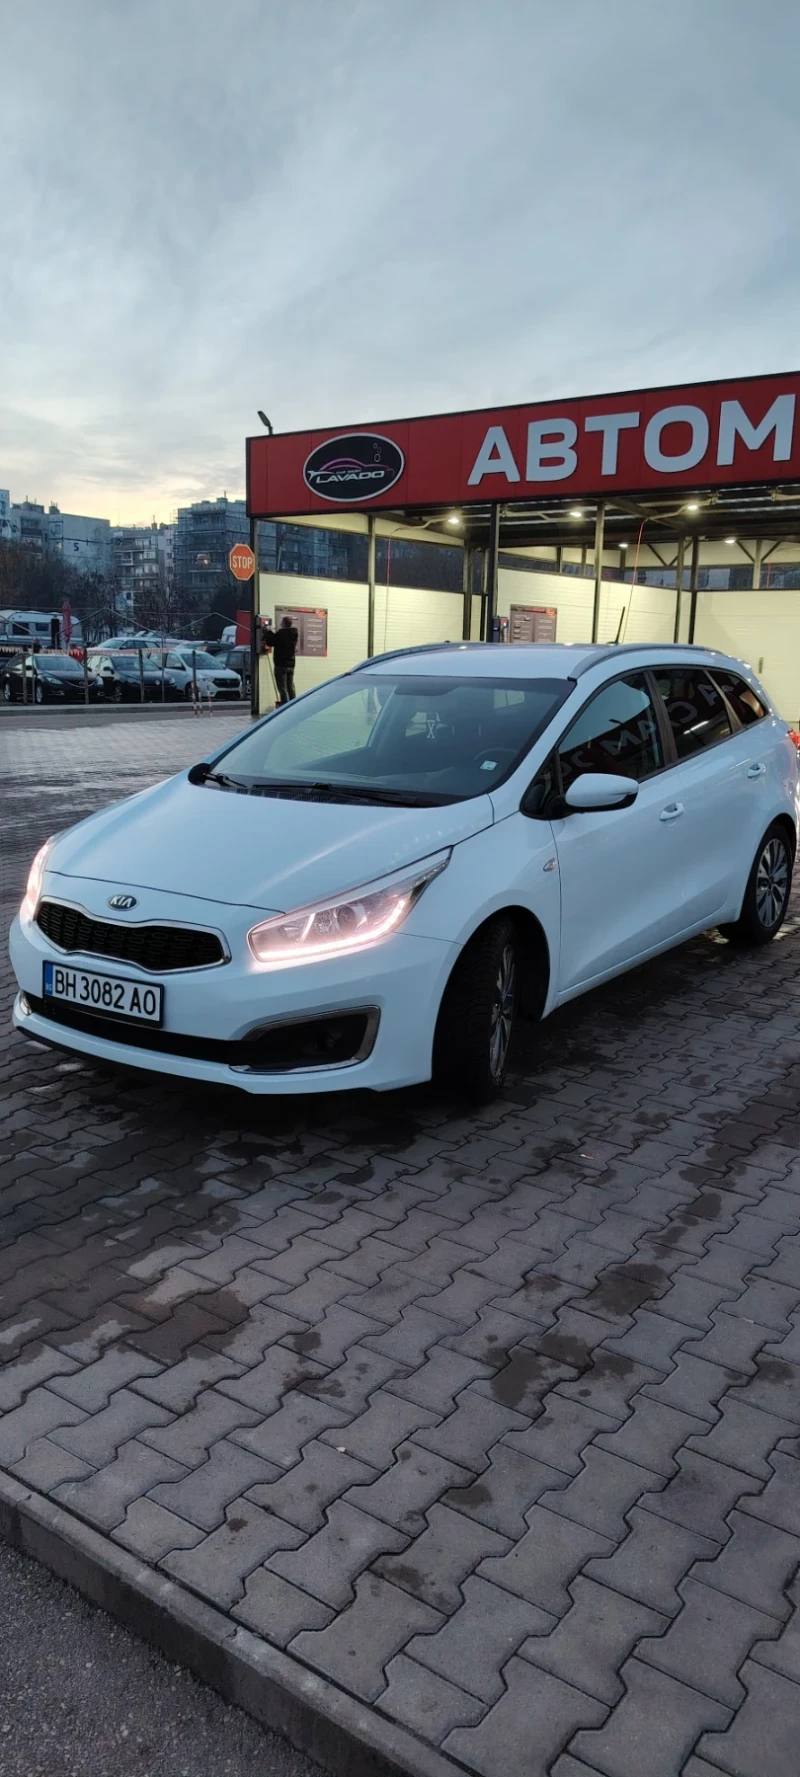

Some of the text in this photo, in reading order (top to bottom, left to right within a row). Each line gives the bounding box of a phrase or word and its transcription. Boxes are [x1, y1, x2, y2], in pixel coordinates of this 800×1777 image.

[467, 394, 796, 486] АВТОМ
[316, 471, 385, 483] LAVADO
[73, 542, 80, 552] 5
[232, 555, 253, 570] STOP
[110, 895, 133, 908] KIA
[80, 976, 125, 1010] 3082
